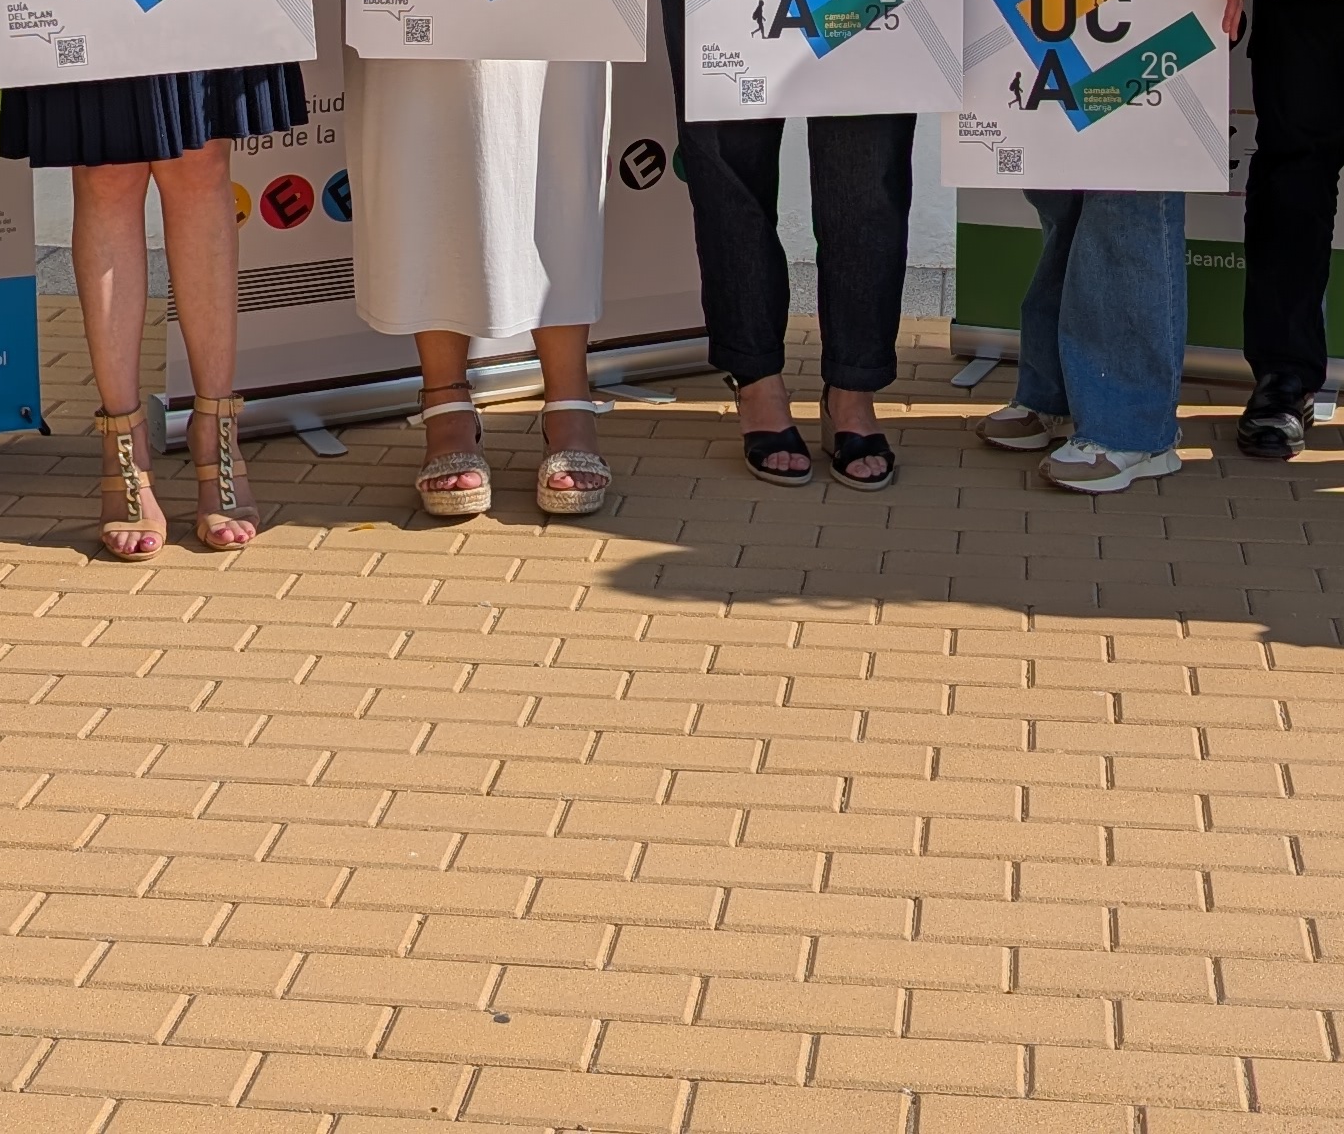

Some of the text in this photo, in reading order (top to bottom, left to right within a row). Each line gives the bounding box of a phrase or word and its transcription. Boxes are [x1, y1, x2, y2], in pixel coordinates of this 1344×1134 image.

[865, 4, 900, 31] 25
[1025, 48, 1079, 111] A
[1141, 52, 1178, 80] 26
[1125, 79, 1162, 106] 25
[282, 124, 336, 148] de la
